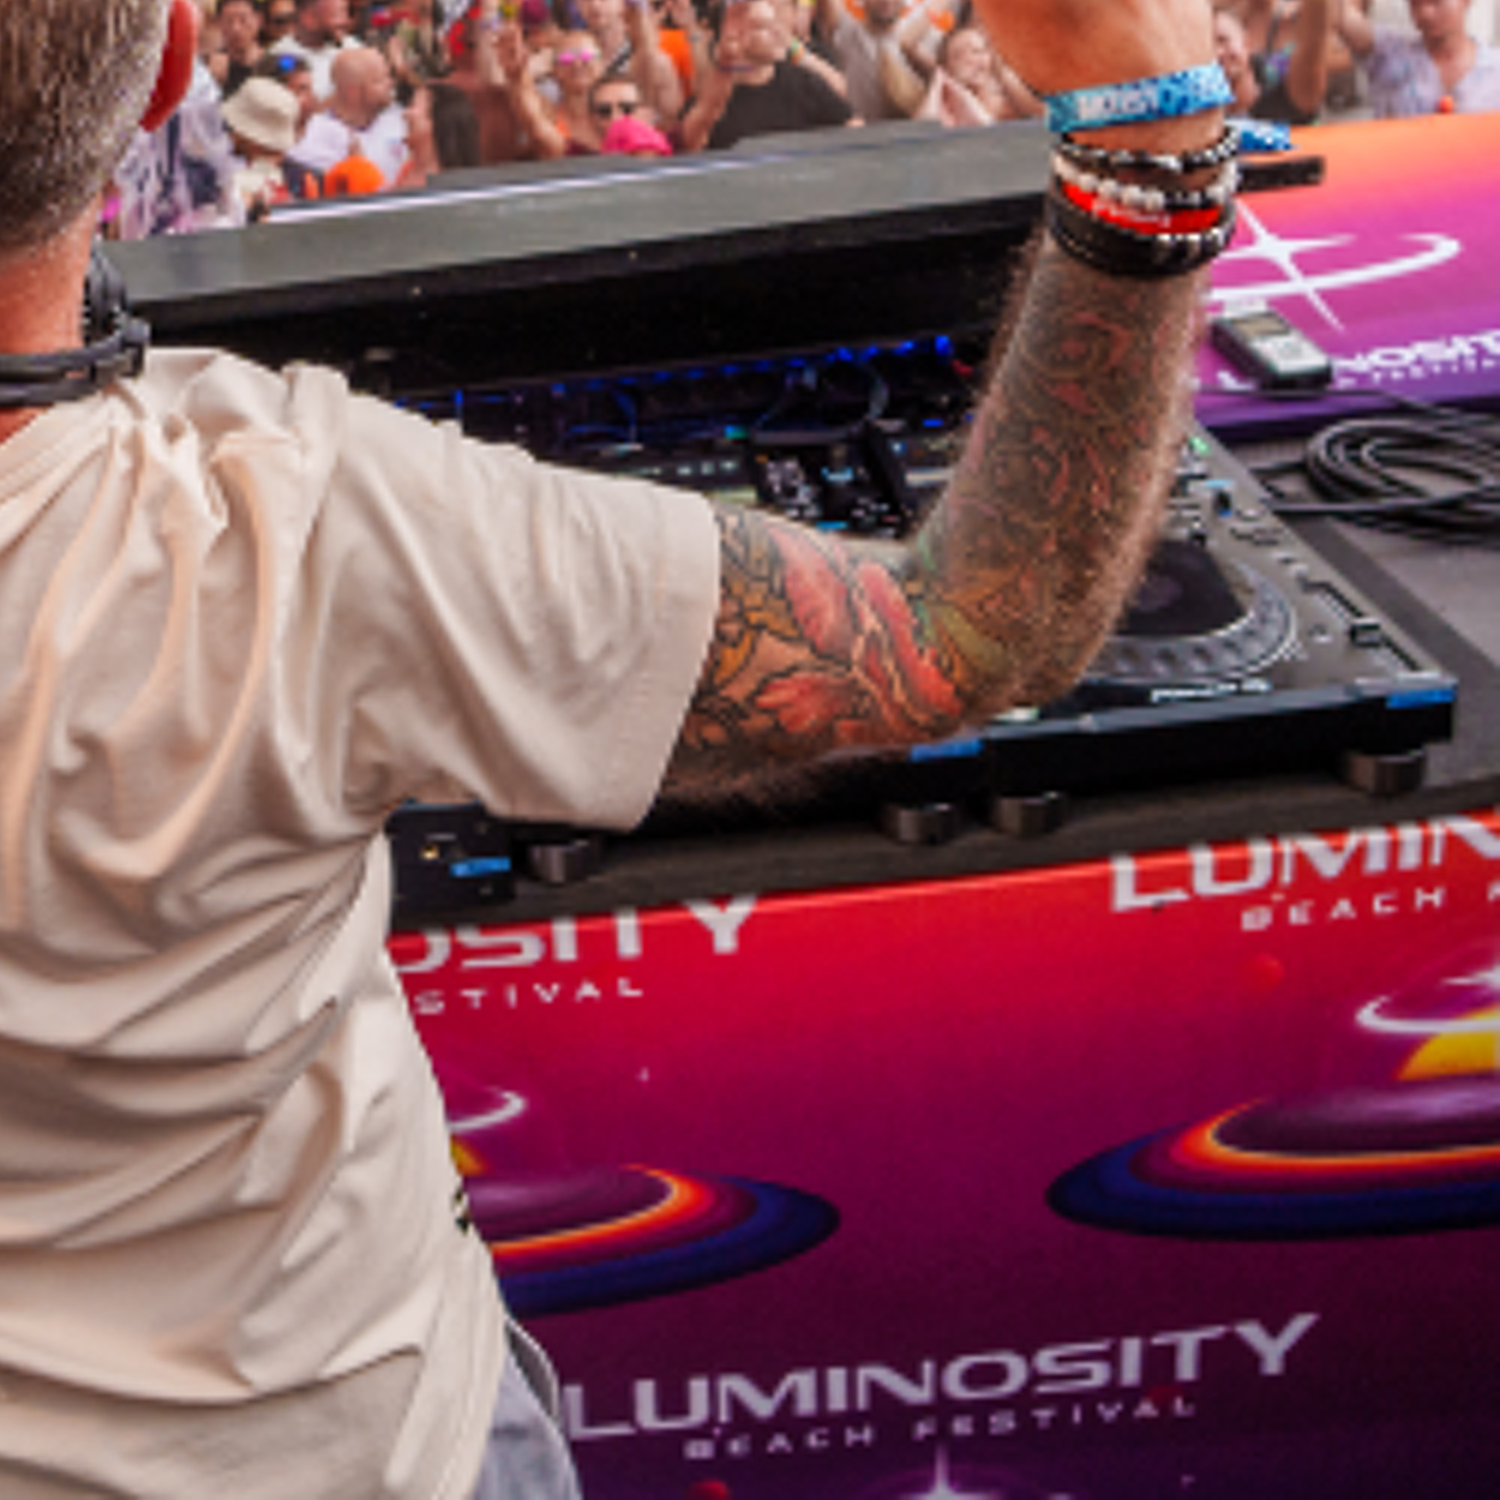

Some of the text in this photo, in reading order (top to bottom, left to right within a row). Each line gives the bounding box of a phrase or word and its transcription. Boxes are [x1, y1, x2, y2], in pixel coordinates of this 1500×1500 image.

[1241, 884, 1445, 933] BEACH
[563, 1313, 1321, 1441] LUMINOSITY
[683, 1396, 1196, 1460] BEACH FESTIVAL
